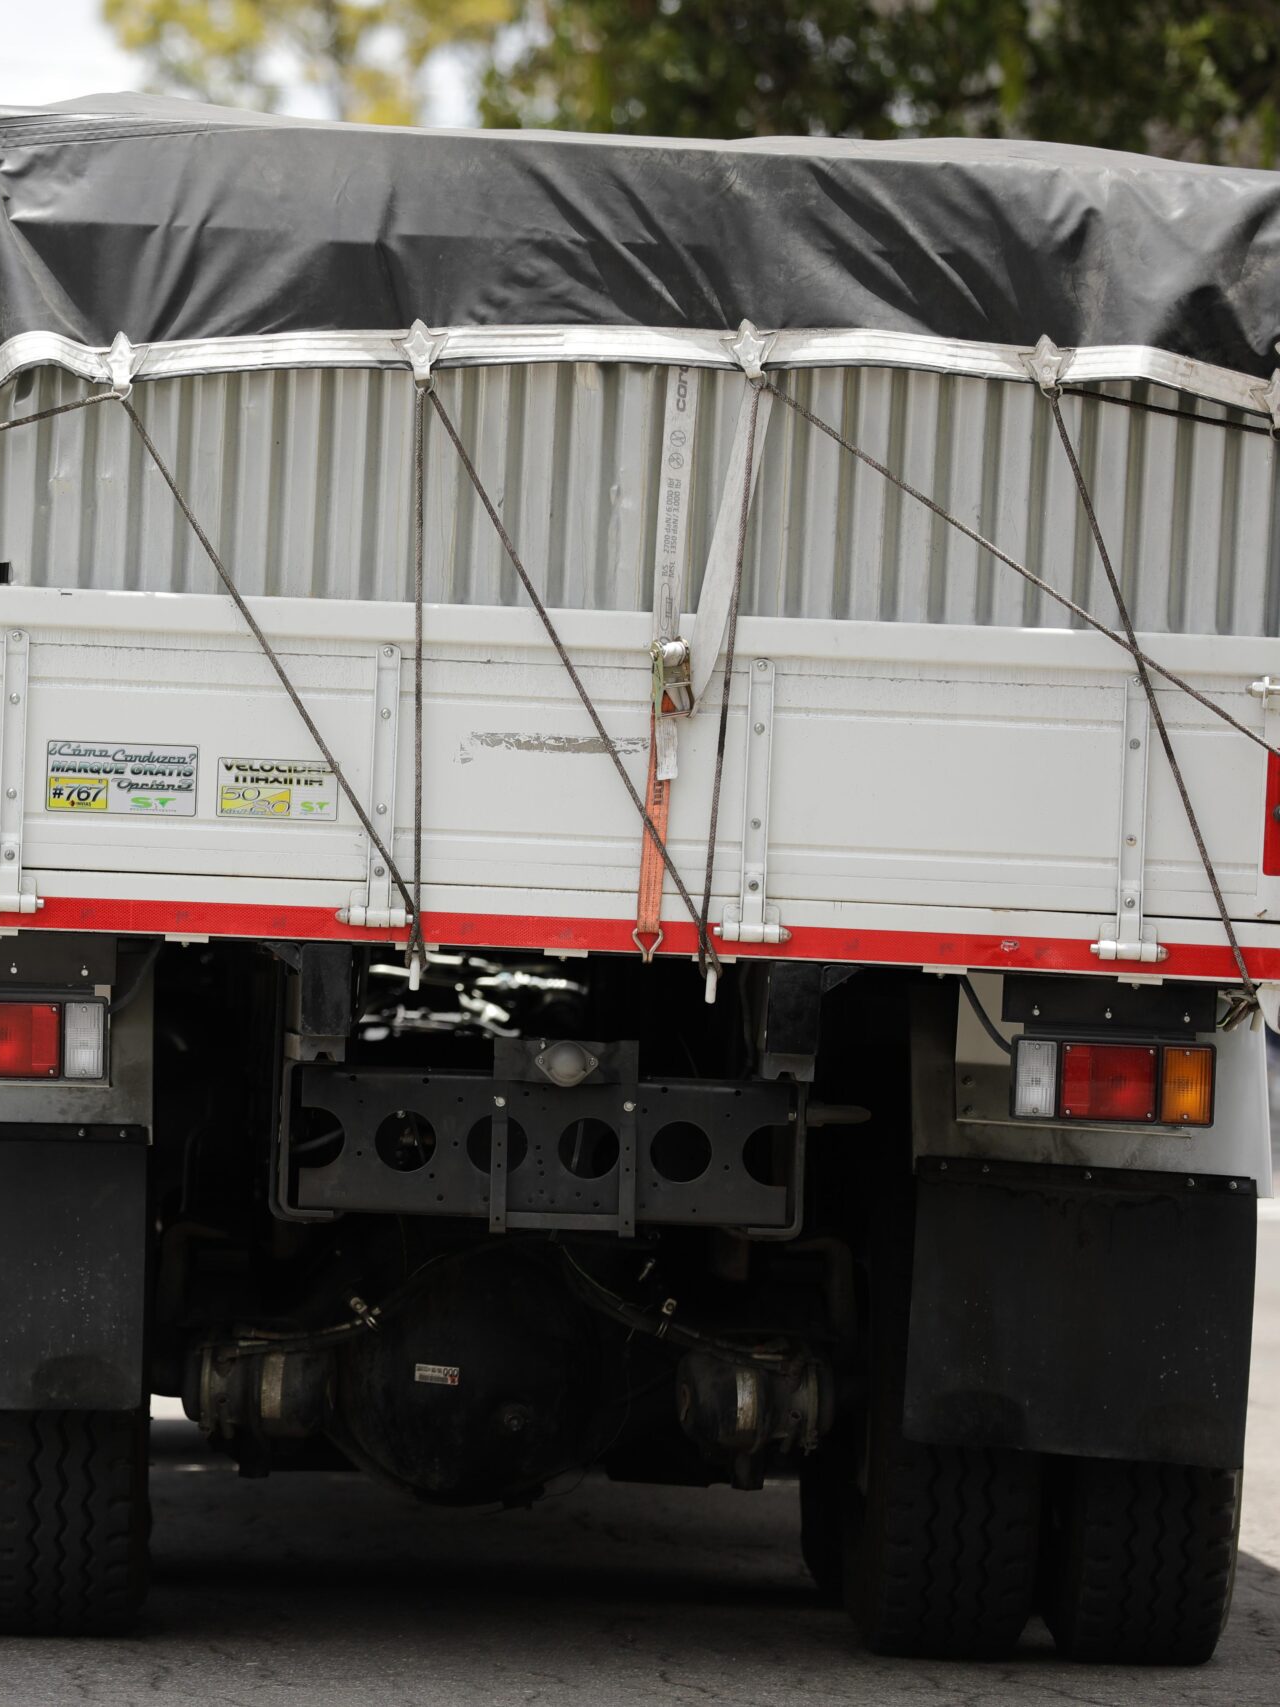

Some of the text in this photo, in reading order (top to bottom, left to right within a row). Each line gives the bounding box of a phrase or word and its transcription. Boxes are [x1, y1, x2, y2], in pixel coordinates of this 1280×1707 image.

[51, 760, 195, 777] MARQUE GRATIS
[52, 784, 106, 802] #767
[221, 787, 261, 801] 50
[251, 799, 290, 815] 80
